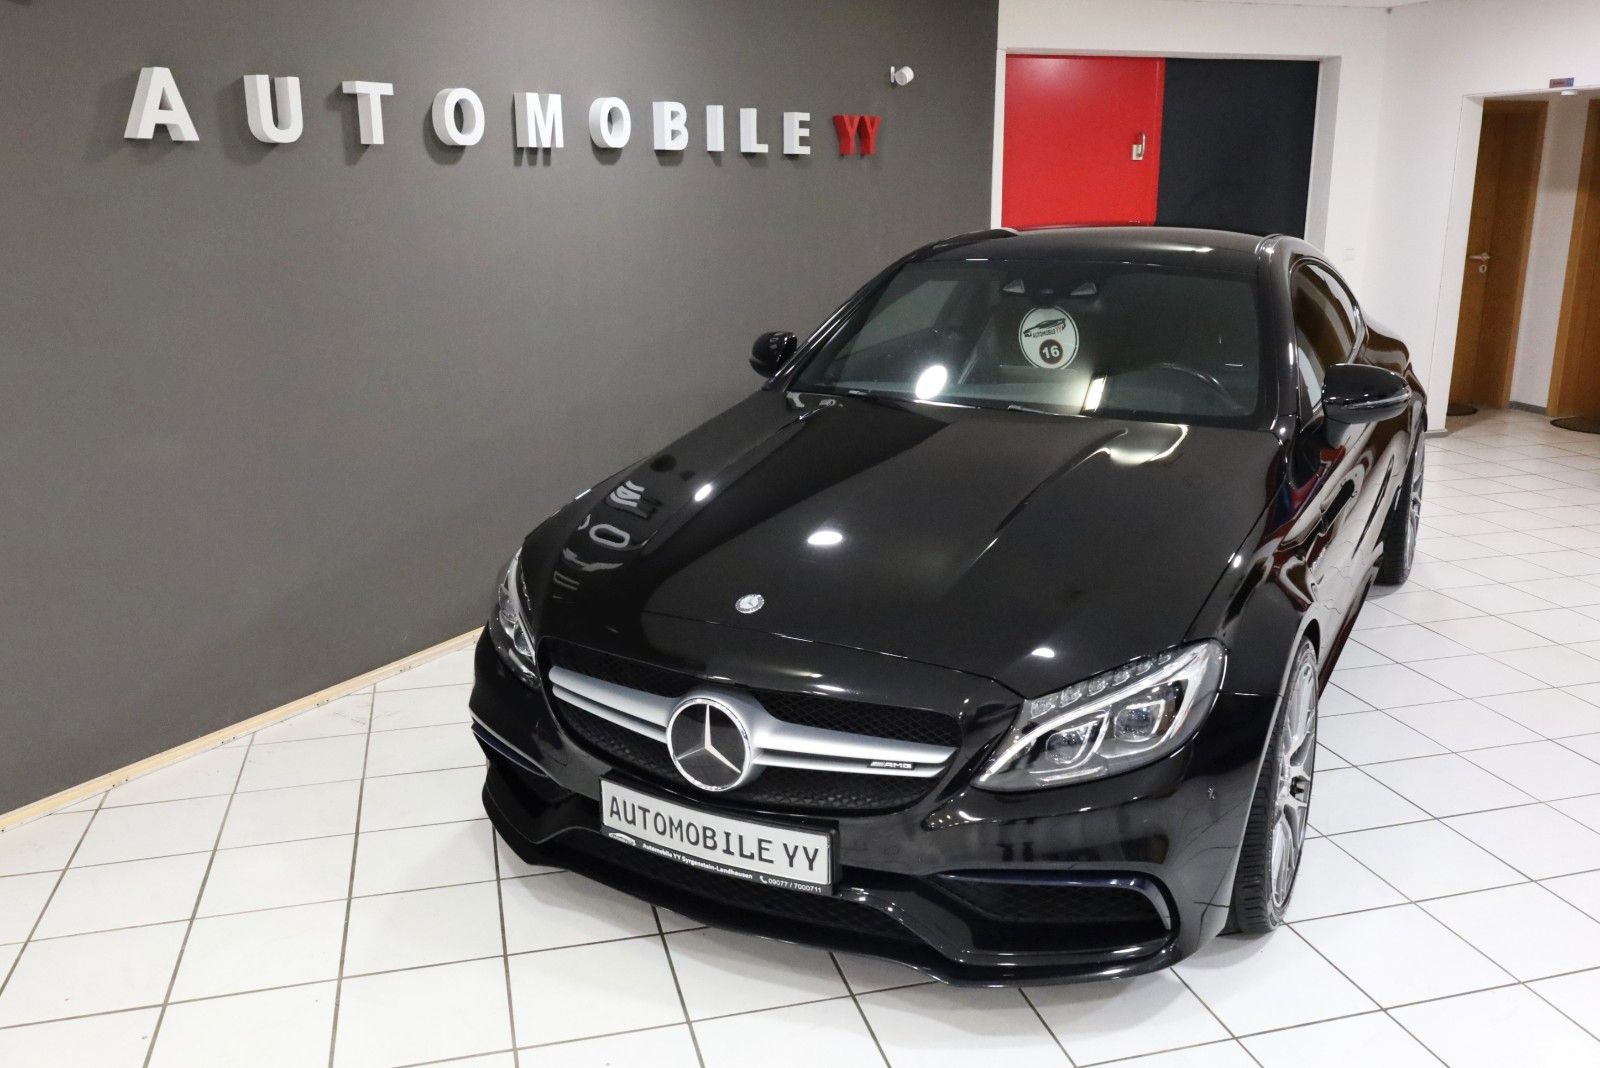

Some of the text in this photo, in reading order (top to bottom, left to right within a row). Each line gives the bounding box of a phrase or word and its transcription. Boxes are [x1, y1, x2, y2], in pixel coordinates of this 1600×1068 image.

[123, 66, 881, 157] AUTOMOBILE YY
[1042, 345, 1060, 359] 16
[609, 795, 820, 872] AUTOMOBILE YY
[642, 843, 673, 858] Automobile
[673, 852, 682, 861] YY
[768, 878, 788, 887] 09077
[794, 883, 822, 892] 7000711
